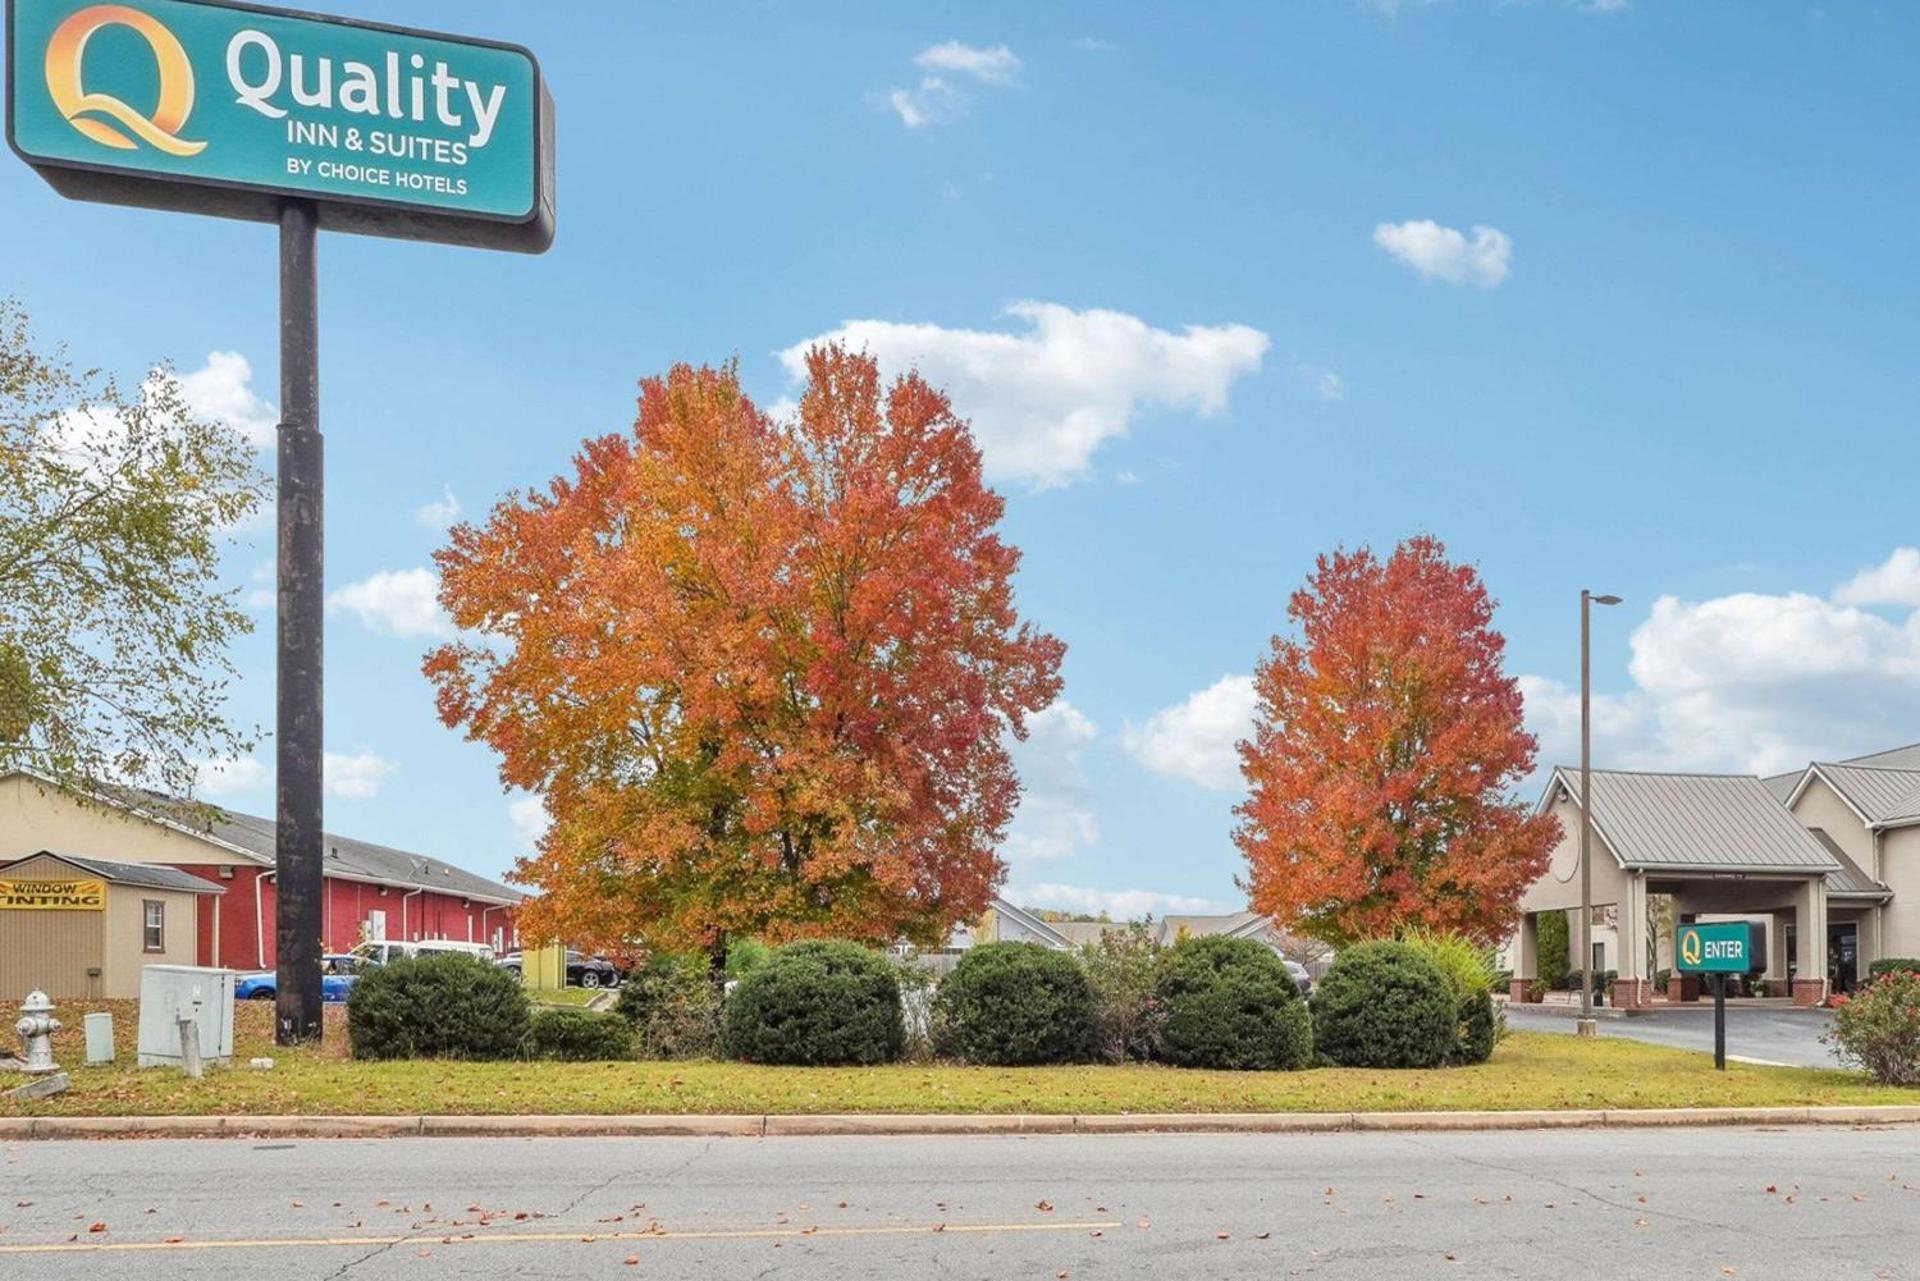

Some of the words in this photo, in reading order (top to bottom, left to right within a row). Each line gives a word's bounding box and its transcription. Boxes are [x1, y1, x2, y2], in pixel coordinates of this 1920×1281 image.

[45, 5, 208, 156] Q
[226, 29, 506, 148] Quality
[287, 120, 338, 148] INN
[345, 127, 363, 151] &
[370, 131, 468, 165] SUITES
[287, 157, 312, 175] BY
[318, 161, 390, 185] CHOICE
[396, 171, 467, 195] HOTELS
[13, 883, 77, 894] WINDOW
[1682, 930, 1701, 964] Q
[1704, 940, 1743, 959] ENTER
